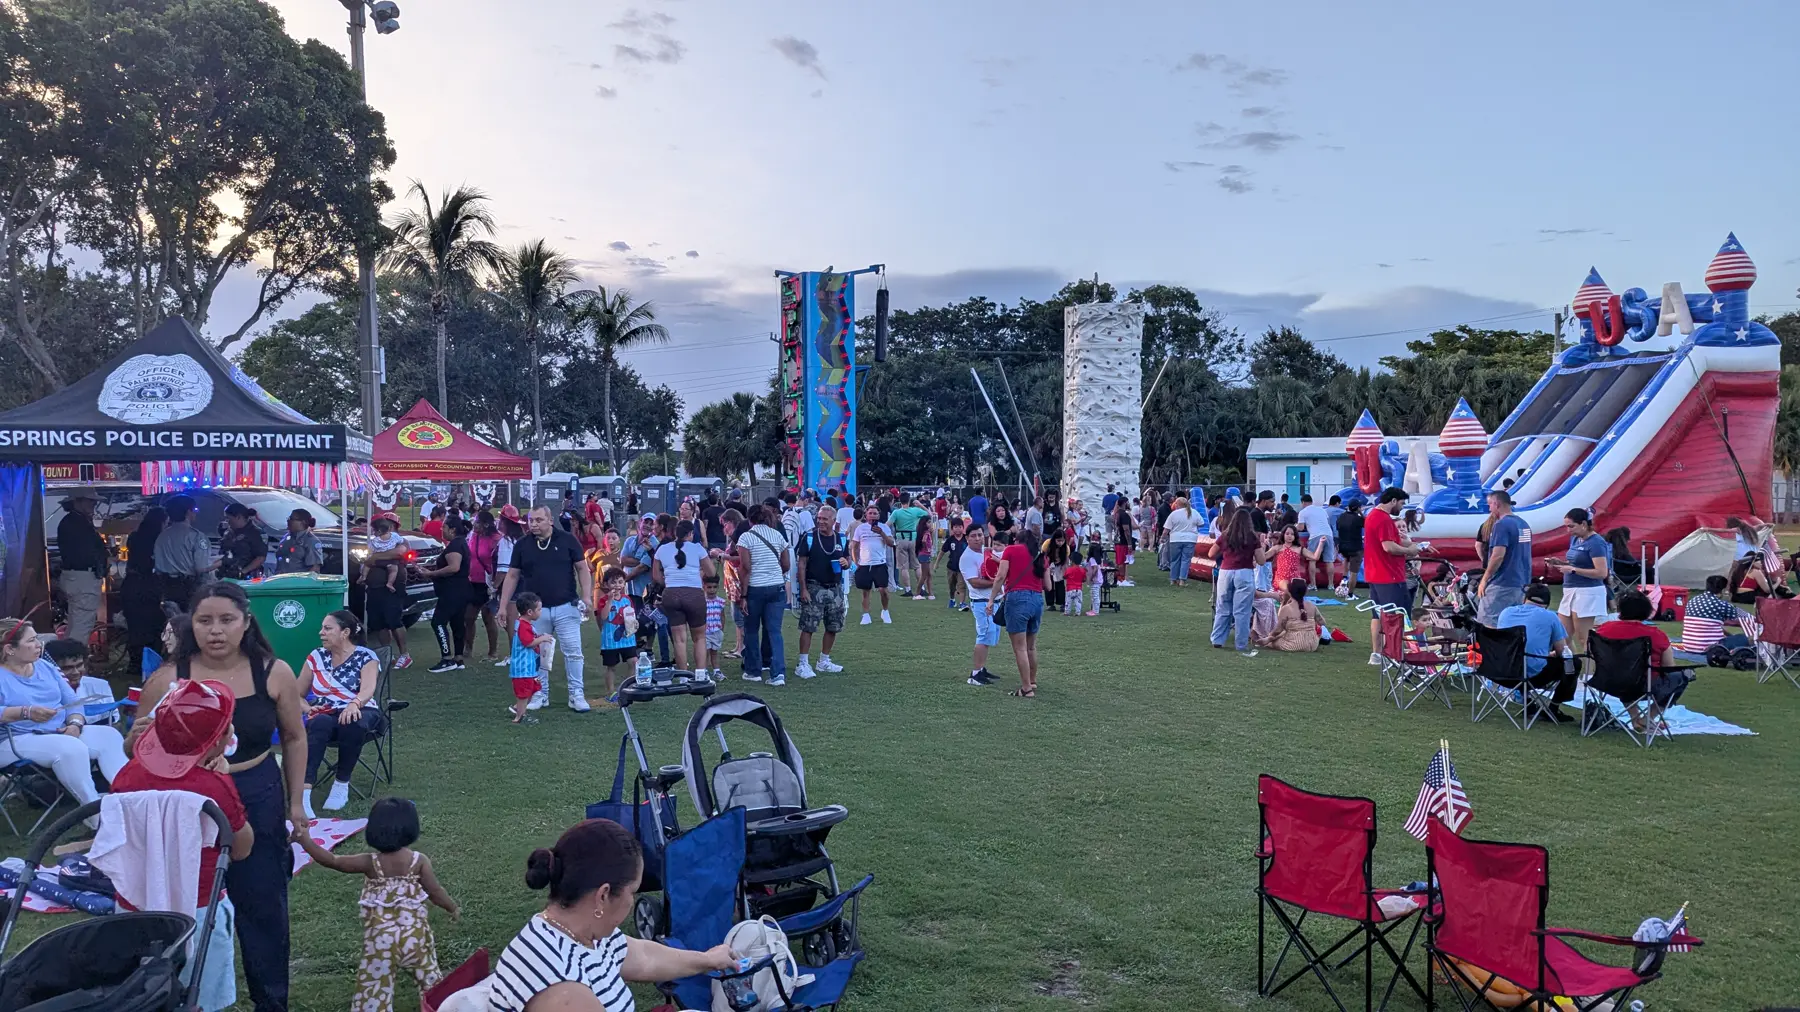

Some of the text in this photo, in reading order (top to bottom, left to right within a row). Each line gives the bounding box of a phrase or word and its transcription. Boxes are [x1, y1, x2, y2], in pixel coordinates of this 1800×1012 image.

[1589, 281, 1694, 347] USA
[127, 377, 149, 387] PALM
[151, 376, 187, 386] SPRINGS
[137, 366, 185, 378] OFFICER
[0, 430, 96, 446] SPRINGS
[106, 431, 184, 447] POLICE
[193, 432, 334, 449] DEPARTMENT
[1354, 440, 1433, 495] USA
